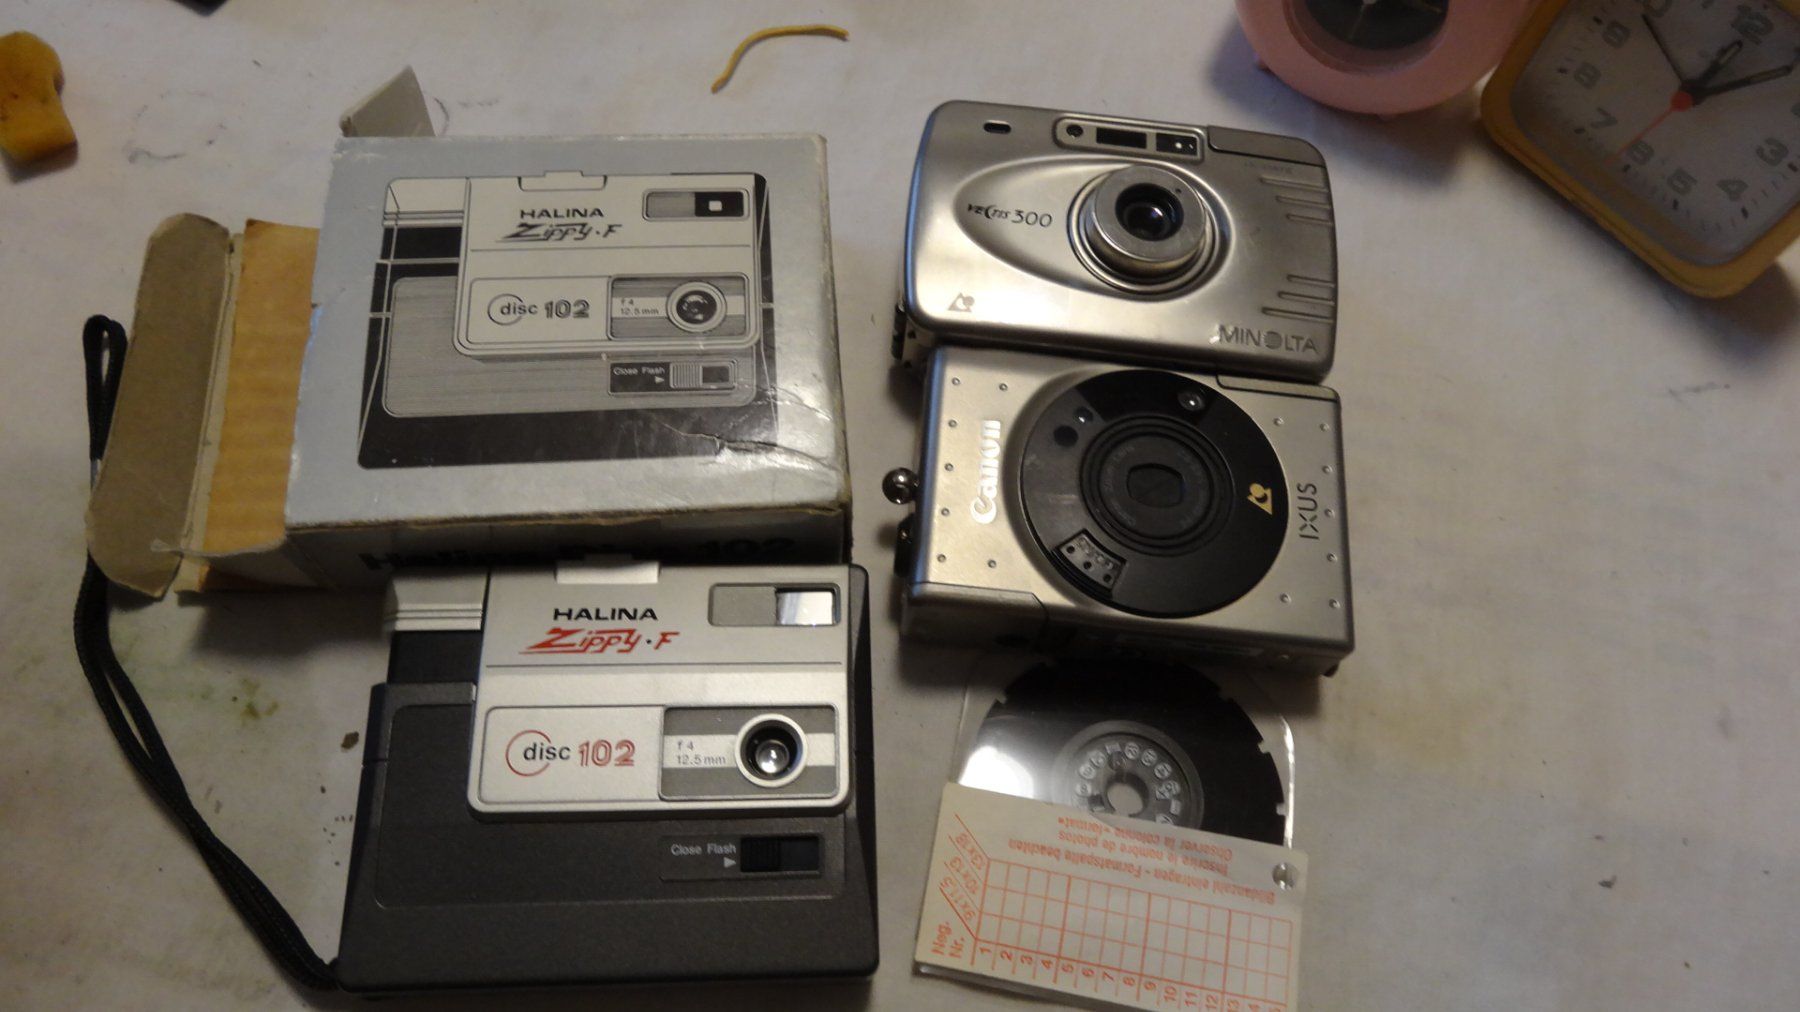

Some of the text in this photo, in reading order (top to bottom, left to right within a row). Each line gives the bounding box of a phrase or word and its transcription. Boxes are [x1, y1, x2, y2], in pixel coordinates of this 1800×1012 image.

[520, 207, 604, 219] HALINA
[1011, 209, 1053, 228] 300
[500, 298, 590, 318] disc 102
[1218, 323, 1319, 354] MINOLTA
[970, 419, 1001, 525] Canon
[1298, 482, 1318, 541] IXUS
[552, 607, 658, 621] HALINA
[523, 739, 636, 767] disc 102
[671, 842, 737, 857] Close Flash
[980, 946, 992, 955] 1
[1001, 949, 1014, 962] 2
[1021, 954, 1034, 967] 3
[1041, 958, 1054, 971] 4
[1081, 966, 1095, 978] 6
[1102, 970, 1116, 982] 7
[1122, 974, 1137, 987] 8
[1143, 980, 1158, 992] 9
[1163, 985, 1178, 1003] 10
[1183, 991, 1199, 1007] 11
[1204, 995, 1219, 1011] 12
